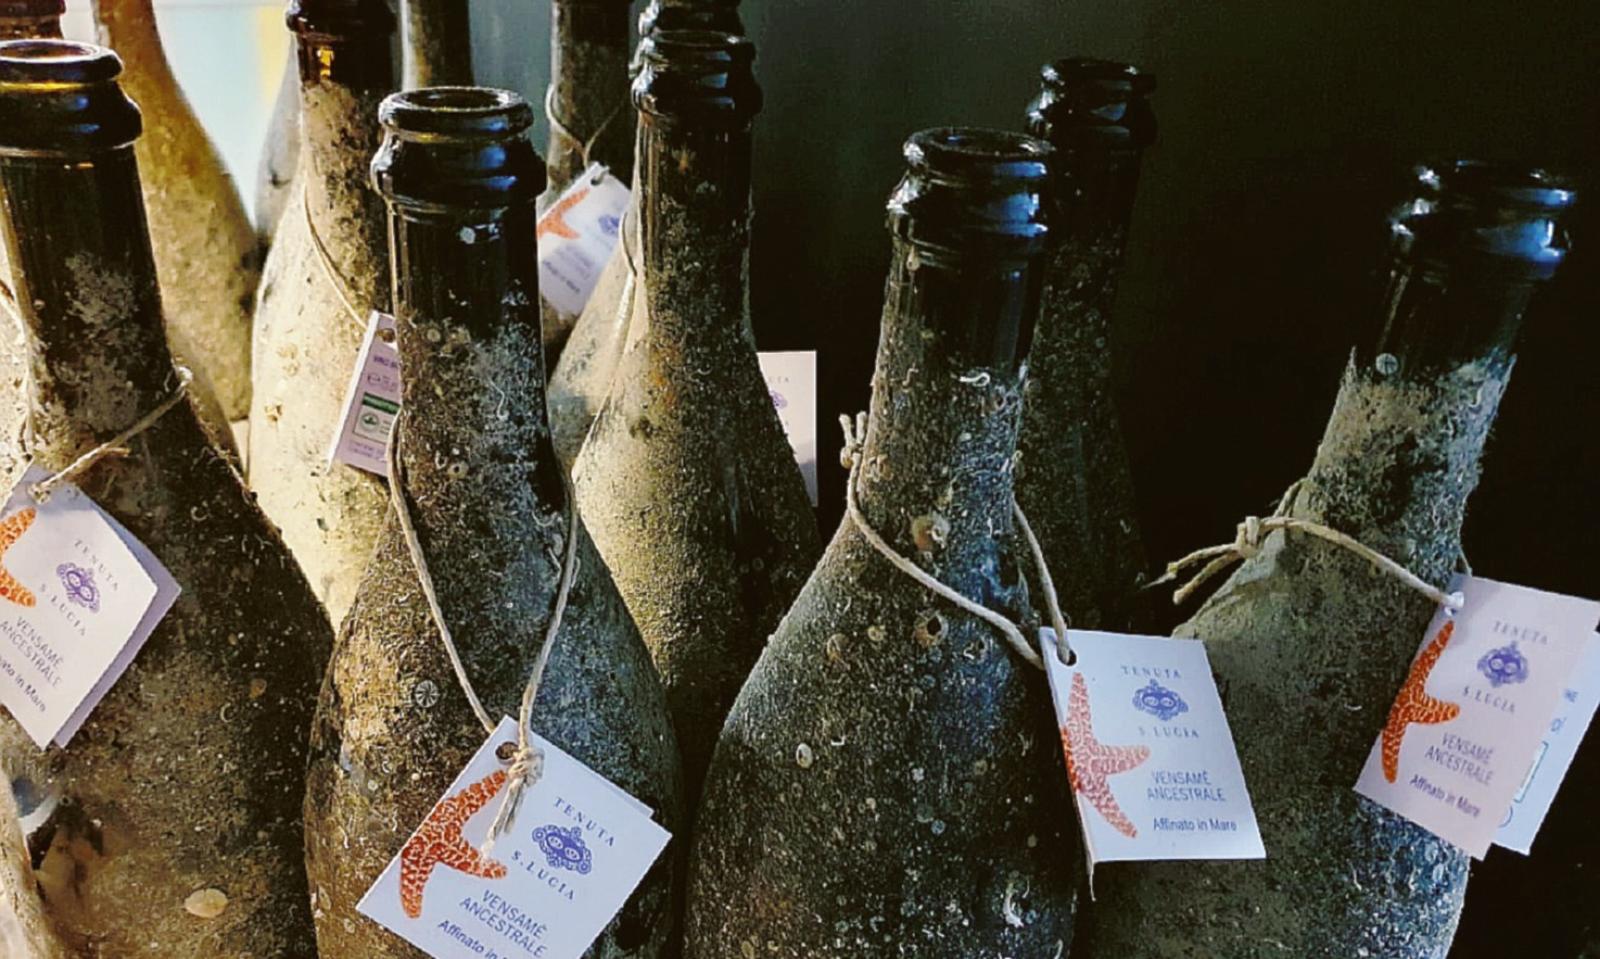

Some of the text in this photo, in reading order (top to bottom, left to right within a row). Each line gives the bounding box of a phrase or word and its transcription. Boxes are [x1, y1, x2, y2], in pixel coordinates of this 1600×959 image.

[1493, 621, 1549, 645] TENUTA
[1121, 665, 1181, 679] TENUTA
[1424, 745, 1494, 786] ANCESTRALE
[1147, 786, 1227, 801] ANCESTRALE
[1409, 774, 1446, 800] Affinato
[553, 796, 616, 848] TENUTA
[1153, 817, 1237, 832] Affinato in Mare
[437, 919, 498, 959] Affinato in
[459, 896, 548, 957] ANCESTRALE
